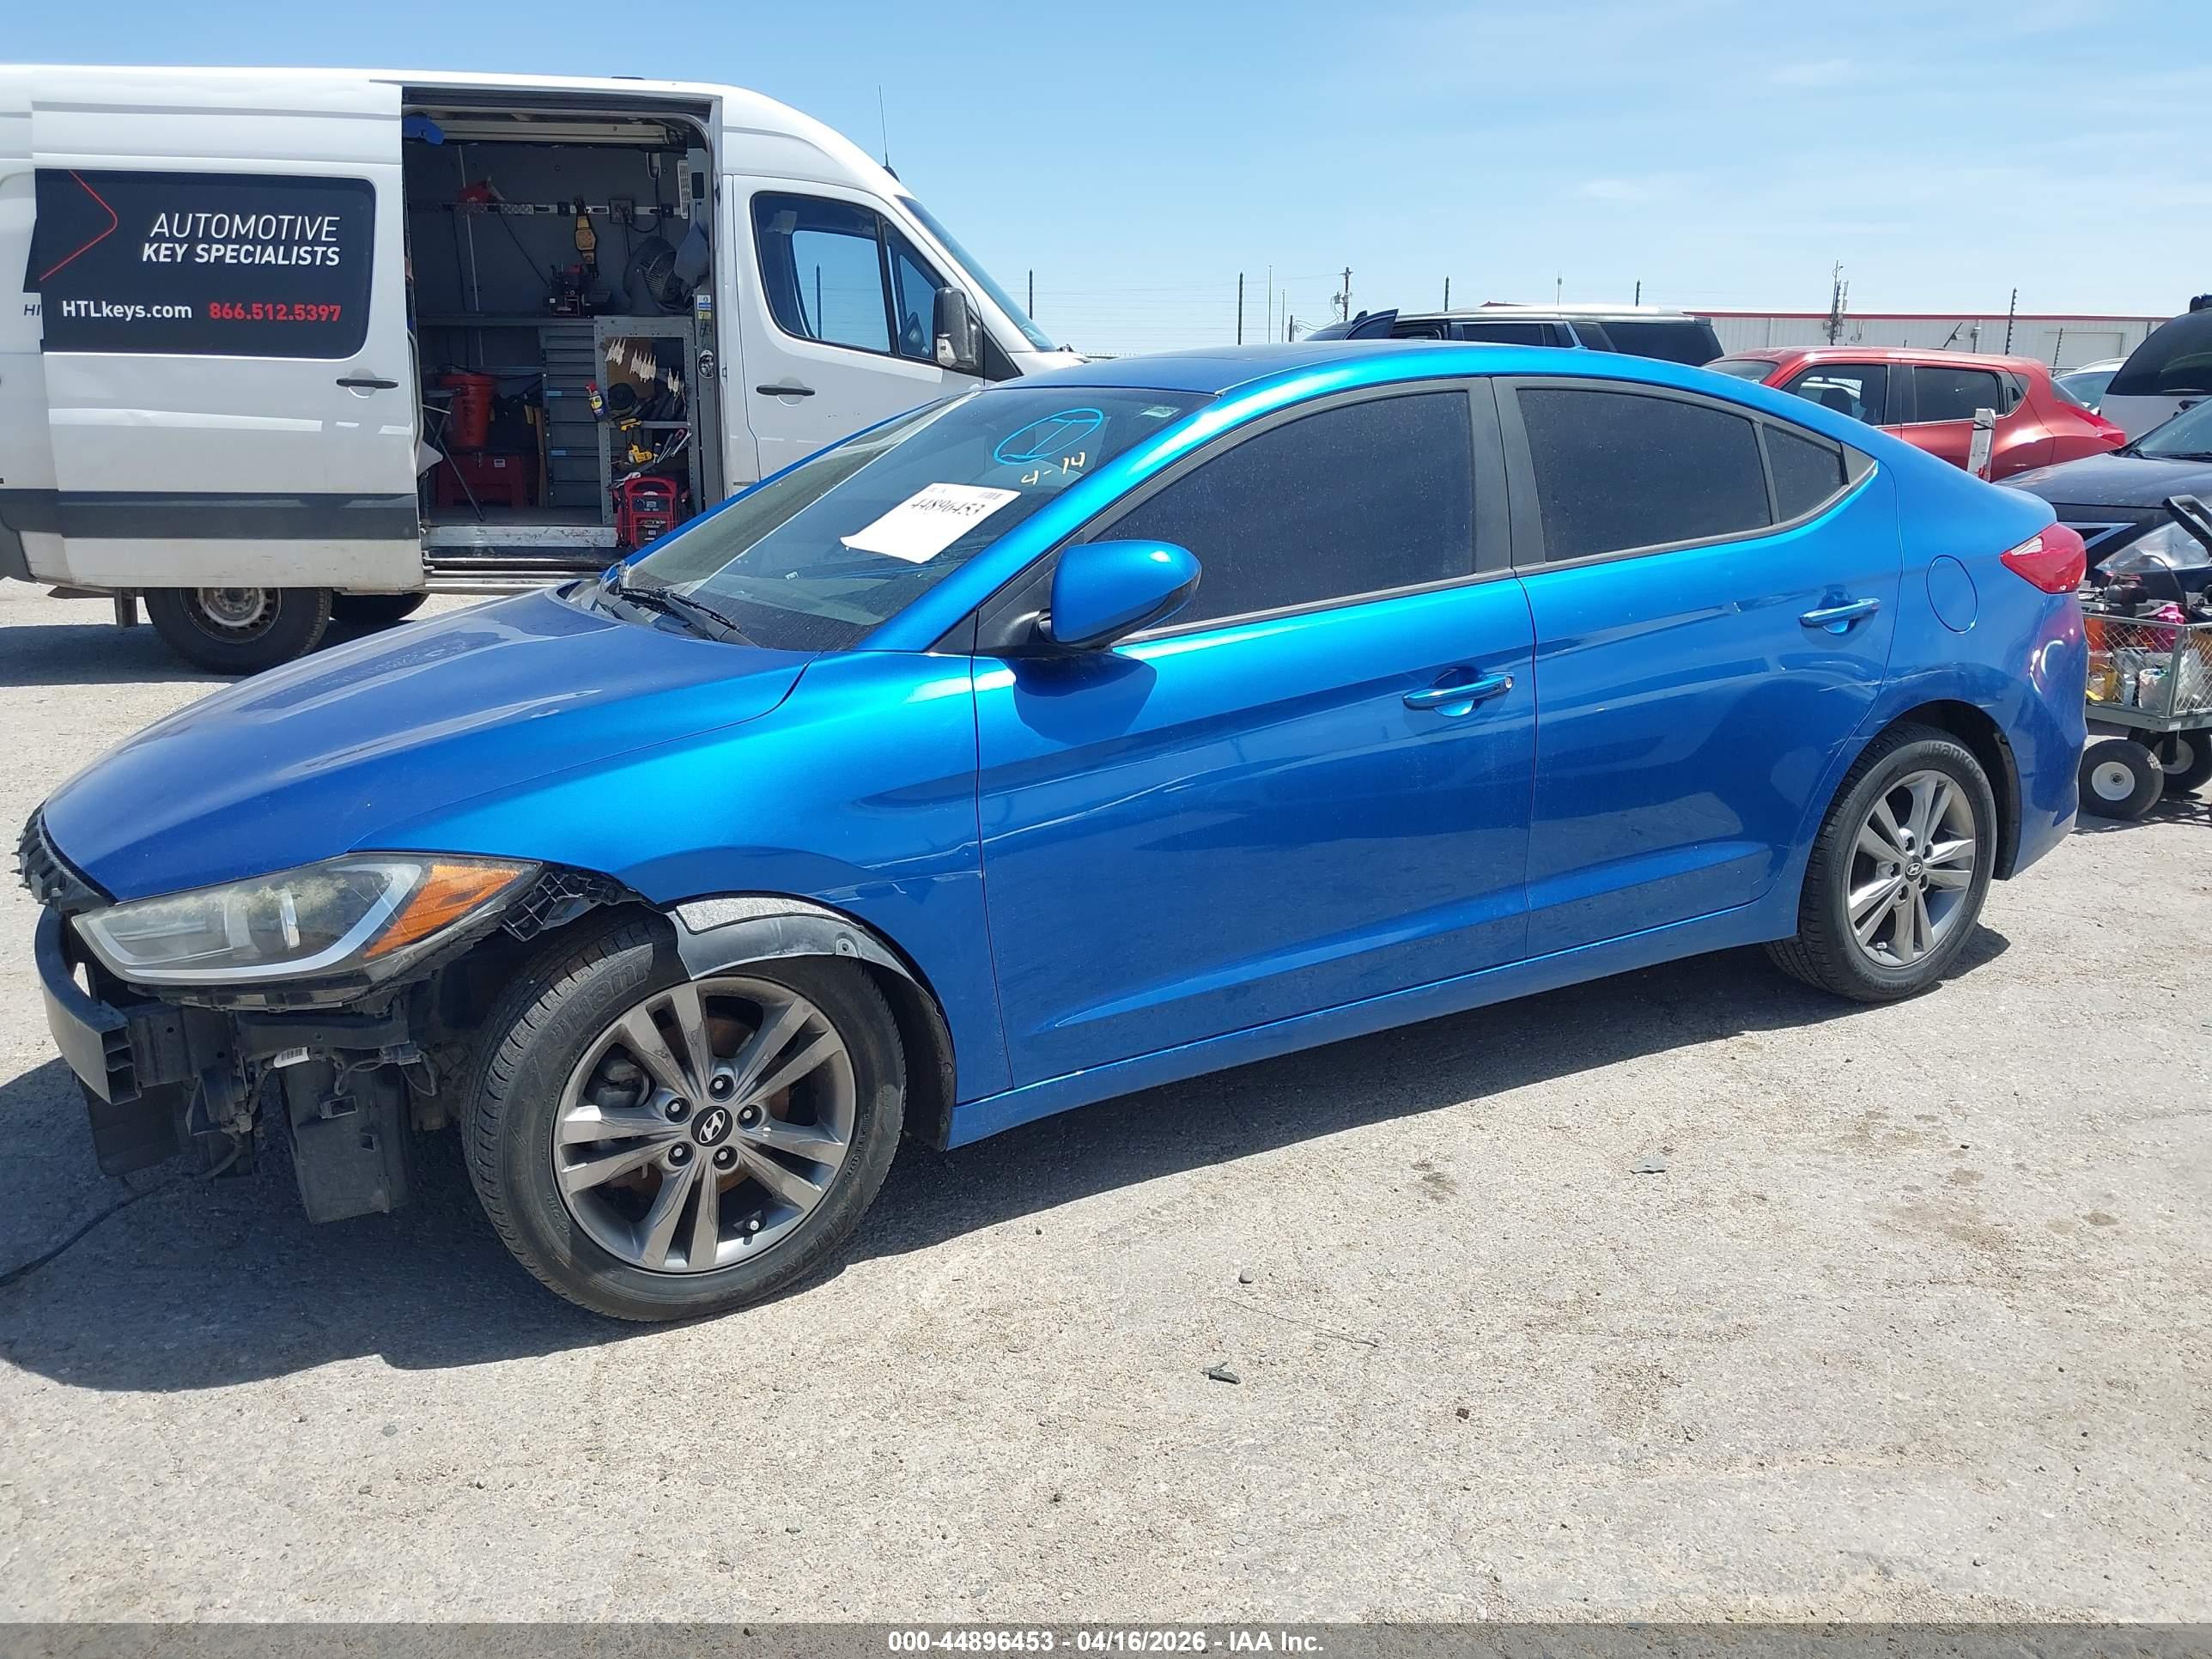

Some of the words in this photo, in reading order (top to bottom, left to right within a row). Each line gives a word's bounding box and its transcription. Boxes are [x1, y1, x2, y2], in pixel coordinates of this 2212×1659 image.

[149, 212, 340, 241] AUTOMOTIVE
[143, 243, 189, 263] KEY
[194, 243, 341, 266] SPECIALISTS
[62, 301, 192, 322] HTLkeys.com
[209, 302, 342, 322] 866.512.5397
